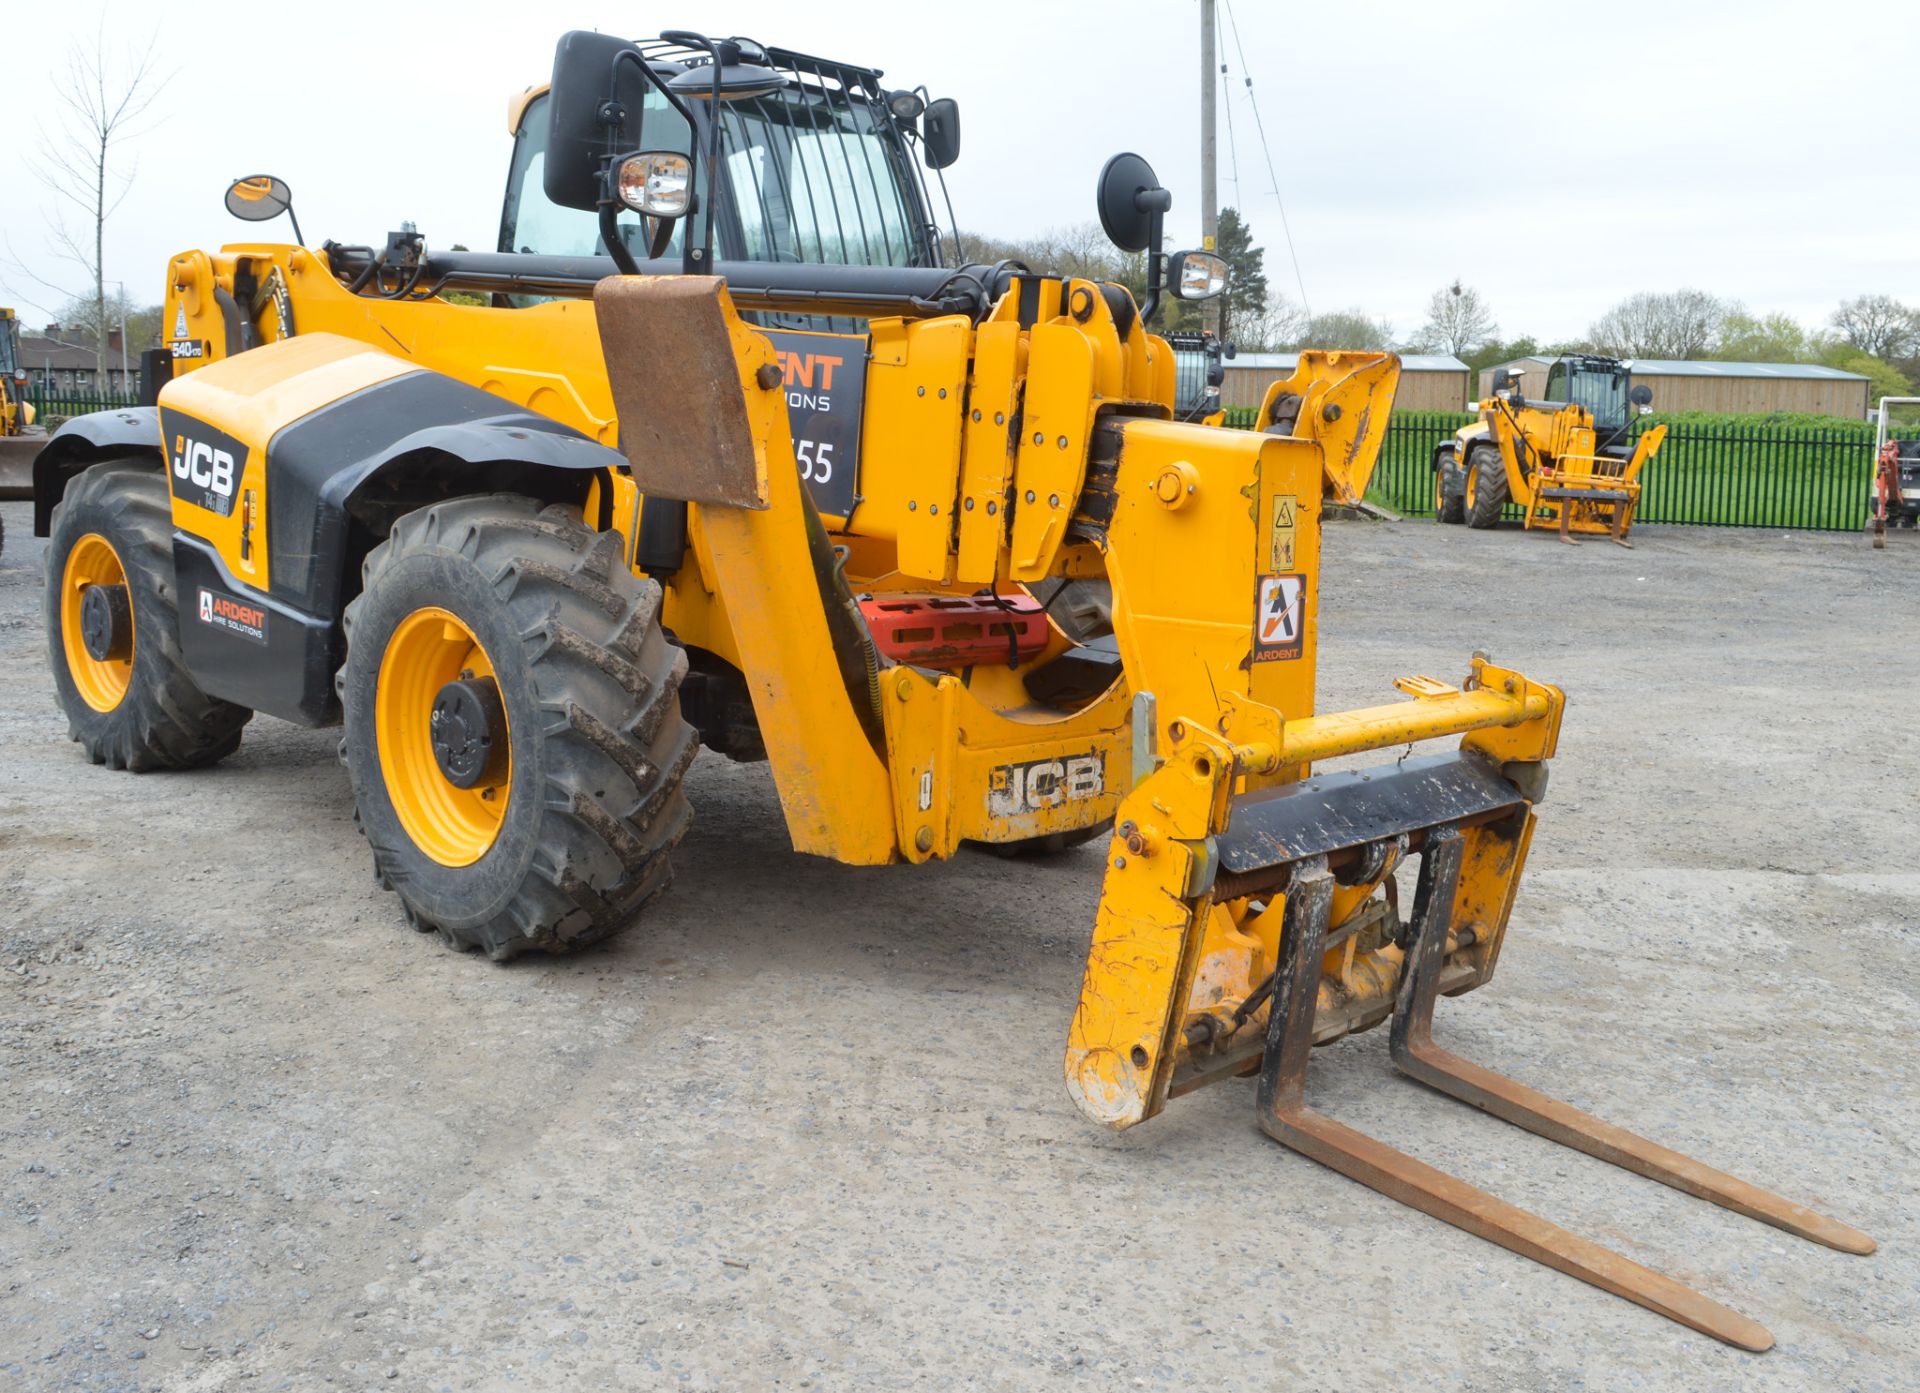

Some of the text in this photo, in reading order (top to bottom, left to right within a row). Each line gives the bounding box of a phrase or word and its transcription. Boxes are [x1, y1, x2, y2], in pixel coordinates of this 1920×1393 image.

[174, 438, 234, 497] JCB
[792, 438, 834, 484] 55
[213, 615, 263, 639] HIRE SOLUTIONS
[214, 598, 264, 628] ARDENT
[1256, 649, 1299, 661] ARDENT
[989, 757, 1103, 818] JCB
